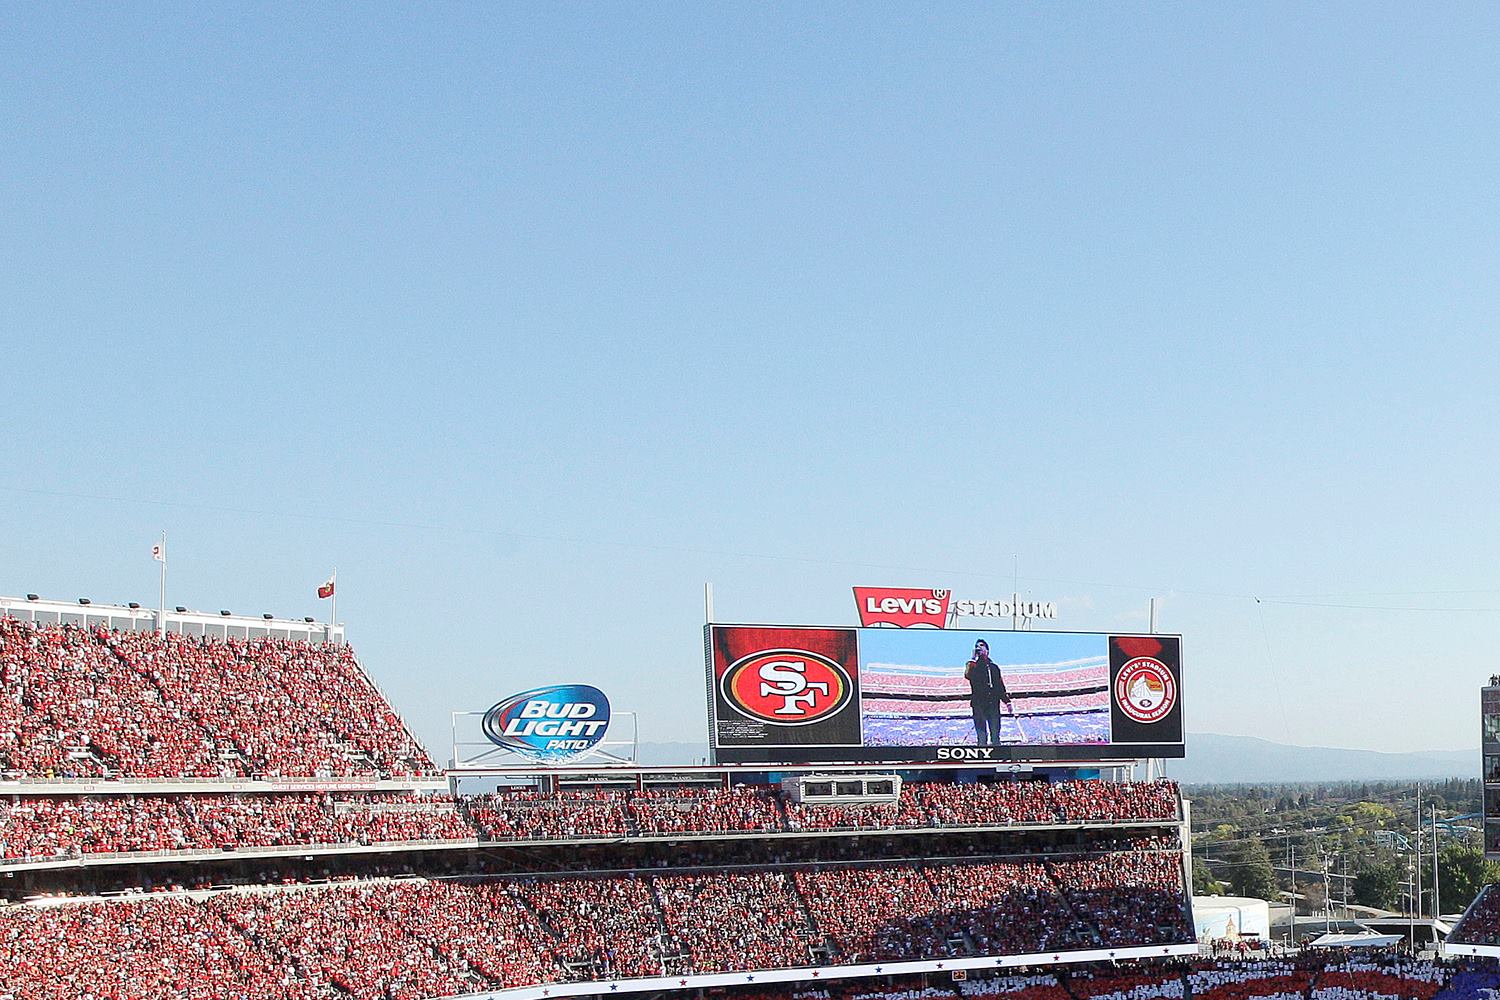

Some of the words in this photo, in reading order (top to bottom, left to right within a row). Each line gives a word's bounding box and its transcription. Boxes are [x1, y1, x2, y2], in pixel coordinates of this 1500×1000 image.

[956, 600, 1057, 619] STADIUM
[1142, 661, 1170, 681] STADIUM
[759, 661, 828, 714] SF
[520, 700, 597, 719] BUD
[503, 719, 607, 736] LIGHT
[545, 739, 589, 750] PATIO
[937, 748, 994, 760] SONY
